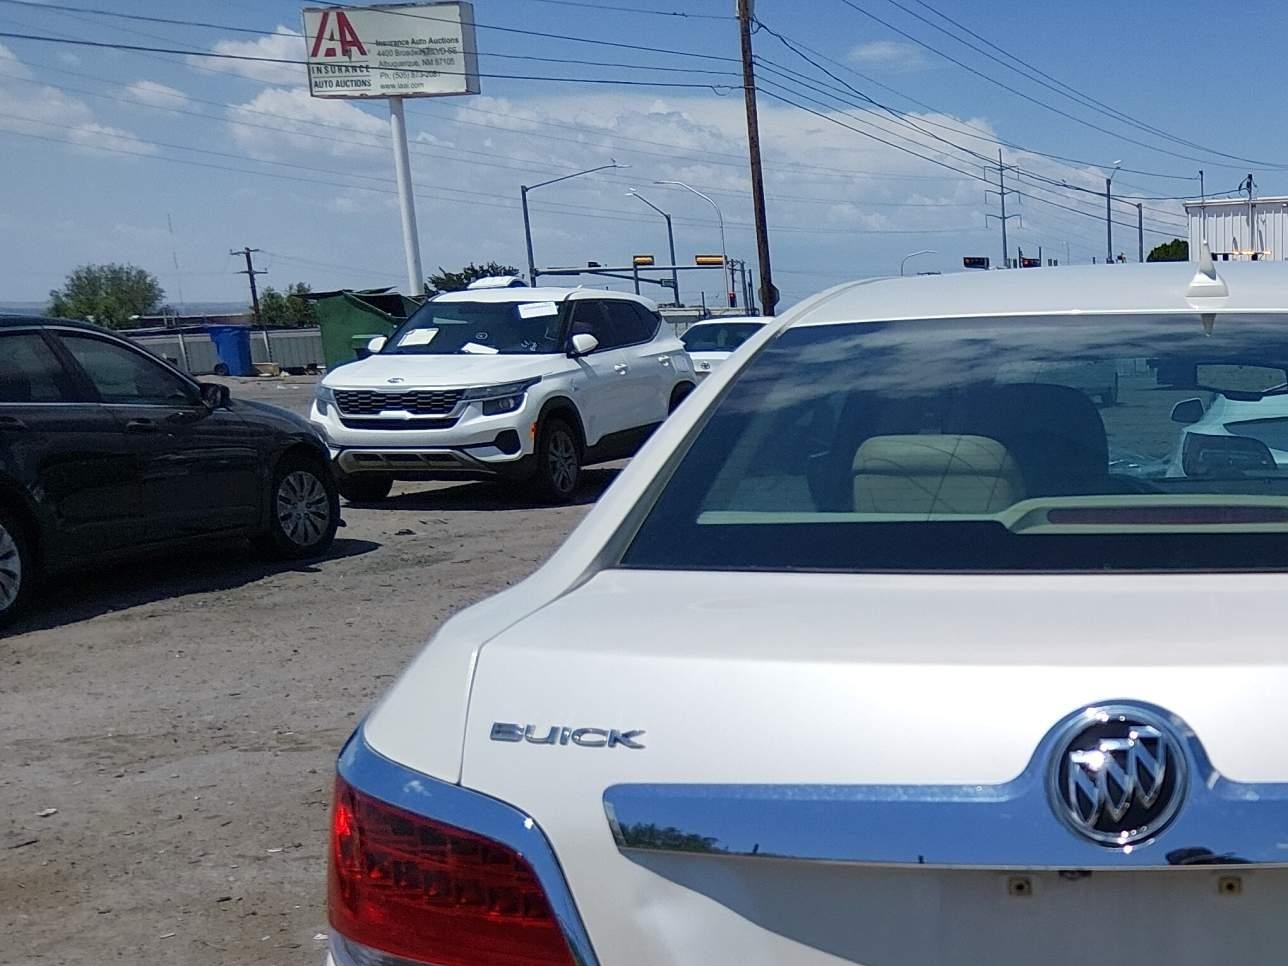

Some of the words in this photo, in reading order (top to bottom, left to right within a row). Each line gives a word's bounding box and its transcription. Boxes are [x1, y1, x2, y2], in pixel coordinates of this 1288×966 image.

[411, 37, 427, 45] Auto
[428, 36, 459, 44] Auctions
[421, 58, 434, 66] NM
[311, 64, 371, 74] INSURANCE
[314, 79, 333, 89] AUTO
[335, 79, 372, 88] AUCTIONS
[489, 722, 647, 749] BUICK
